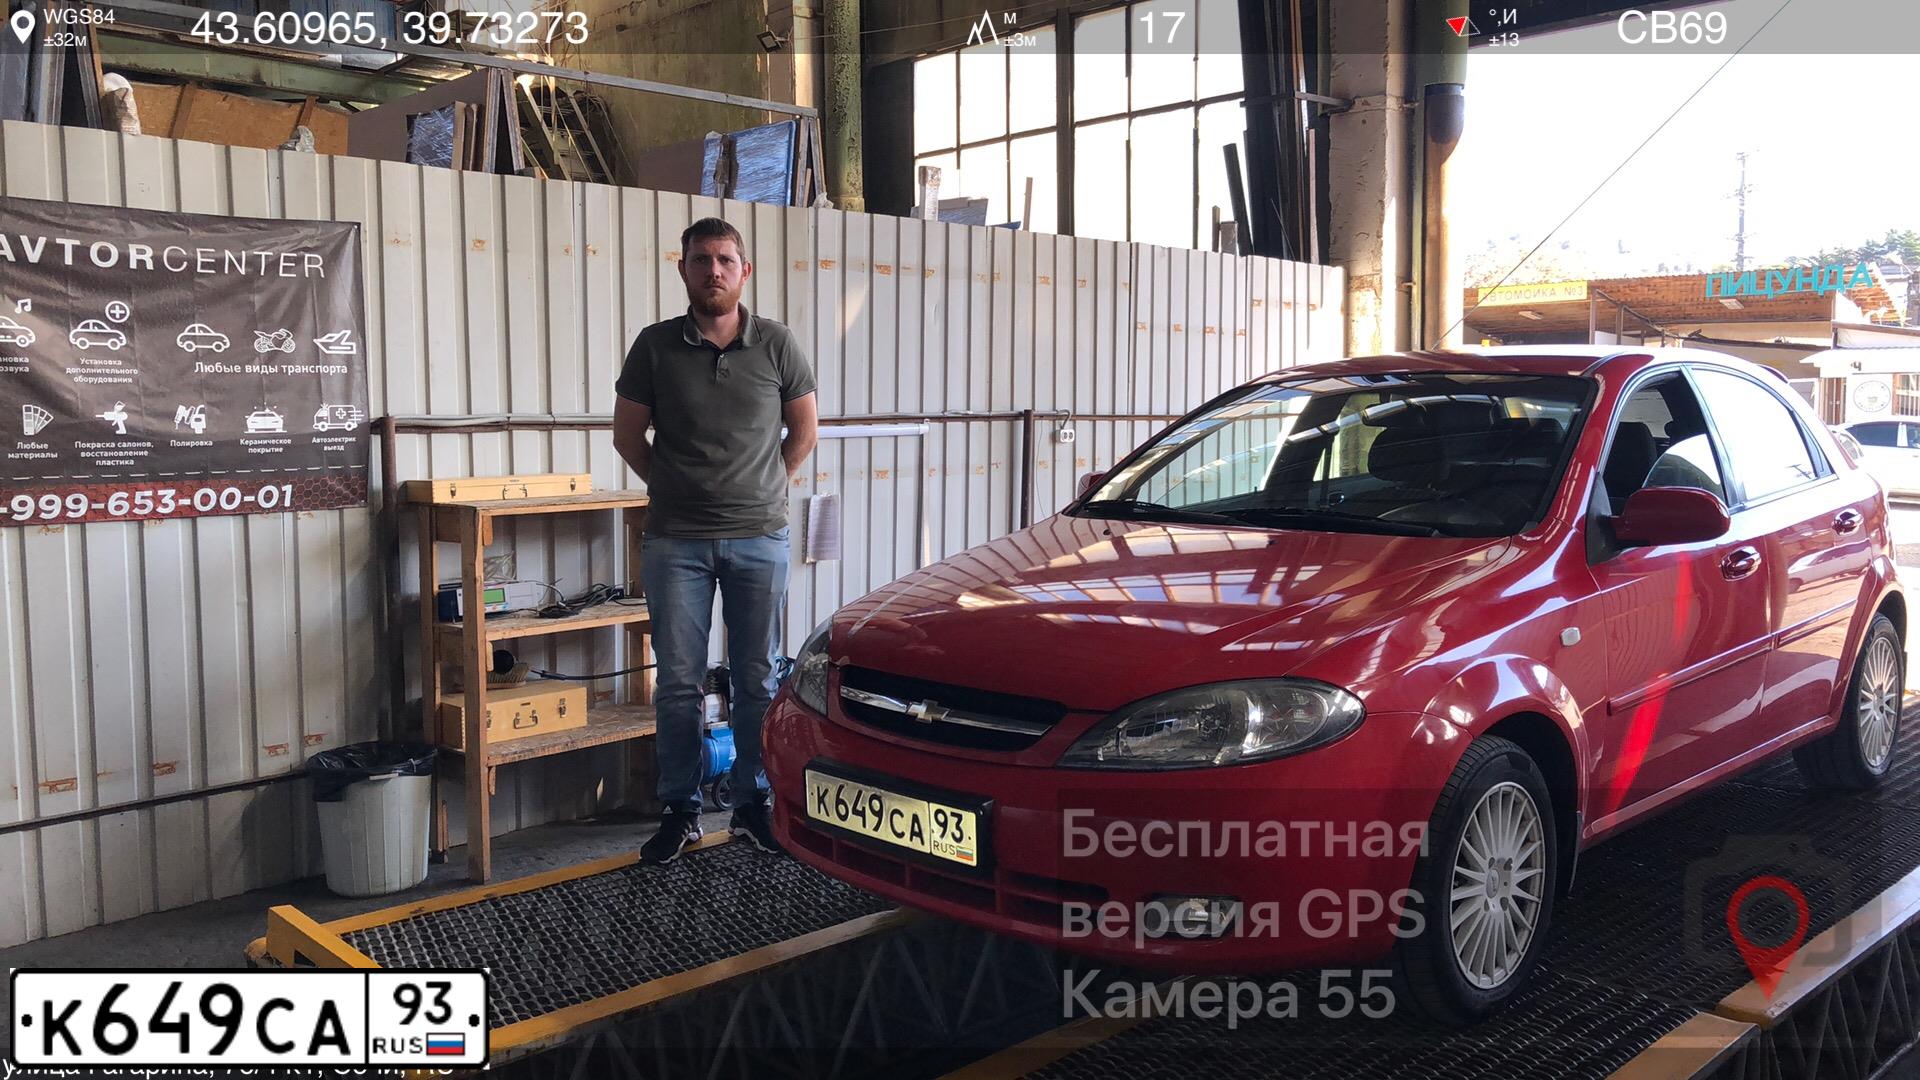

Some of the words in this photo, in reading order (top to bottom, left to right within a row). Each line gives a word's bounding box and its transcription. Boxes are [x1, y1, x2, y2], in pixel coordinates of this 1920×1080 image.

[1705, 261, 1873, 299] ПИЦУНДА
[80, 358, 122, 366] Установка
[66, 366, 139, 375] дополнительного
[194, 362, 241, 374] Любые
[245, 364, 279, 374] виды
[281, 365, 348, 375] транспорта
[73, 375, 133, 384] оборудования
[170, 439, 213, 447] Полировка
[239, 438, 292, 446] Керамическое
[311, 436, 357, 444] Автоэлектрик
[17, 442, 49, 450] Любые
[75, 441, 116, 450] Покраска
[117, 440, 154, 448] салонов,
[80, 450, 149, 458] восстановление
[248, 446, 284, 454] покрытие
[8, 452, 58, 460] материалы
[817, 784, 925, 846] К649СА
[933, 808, 964, 844] 93
[933, 840, 956, 856] RUS
